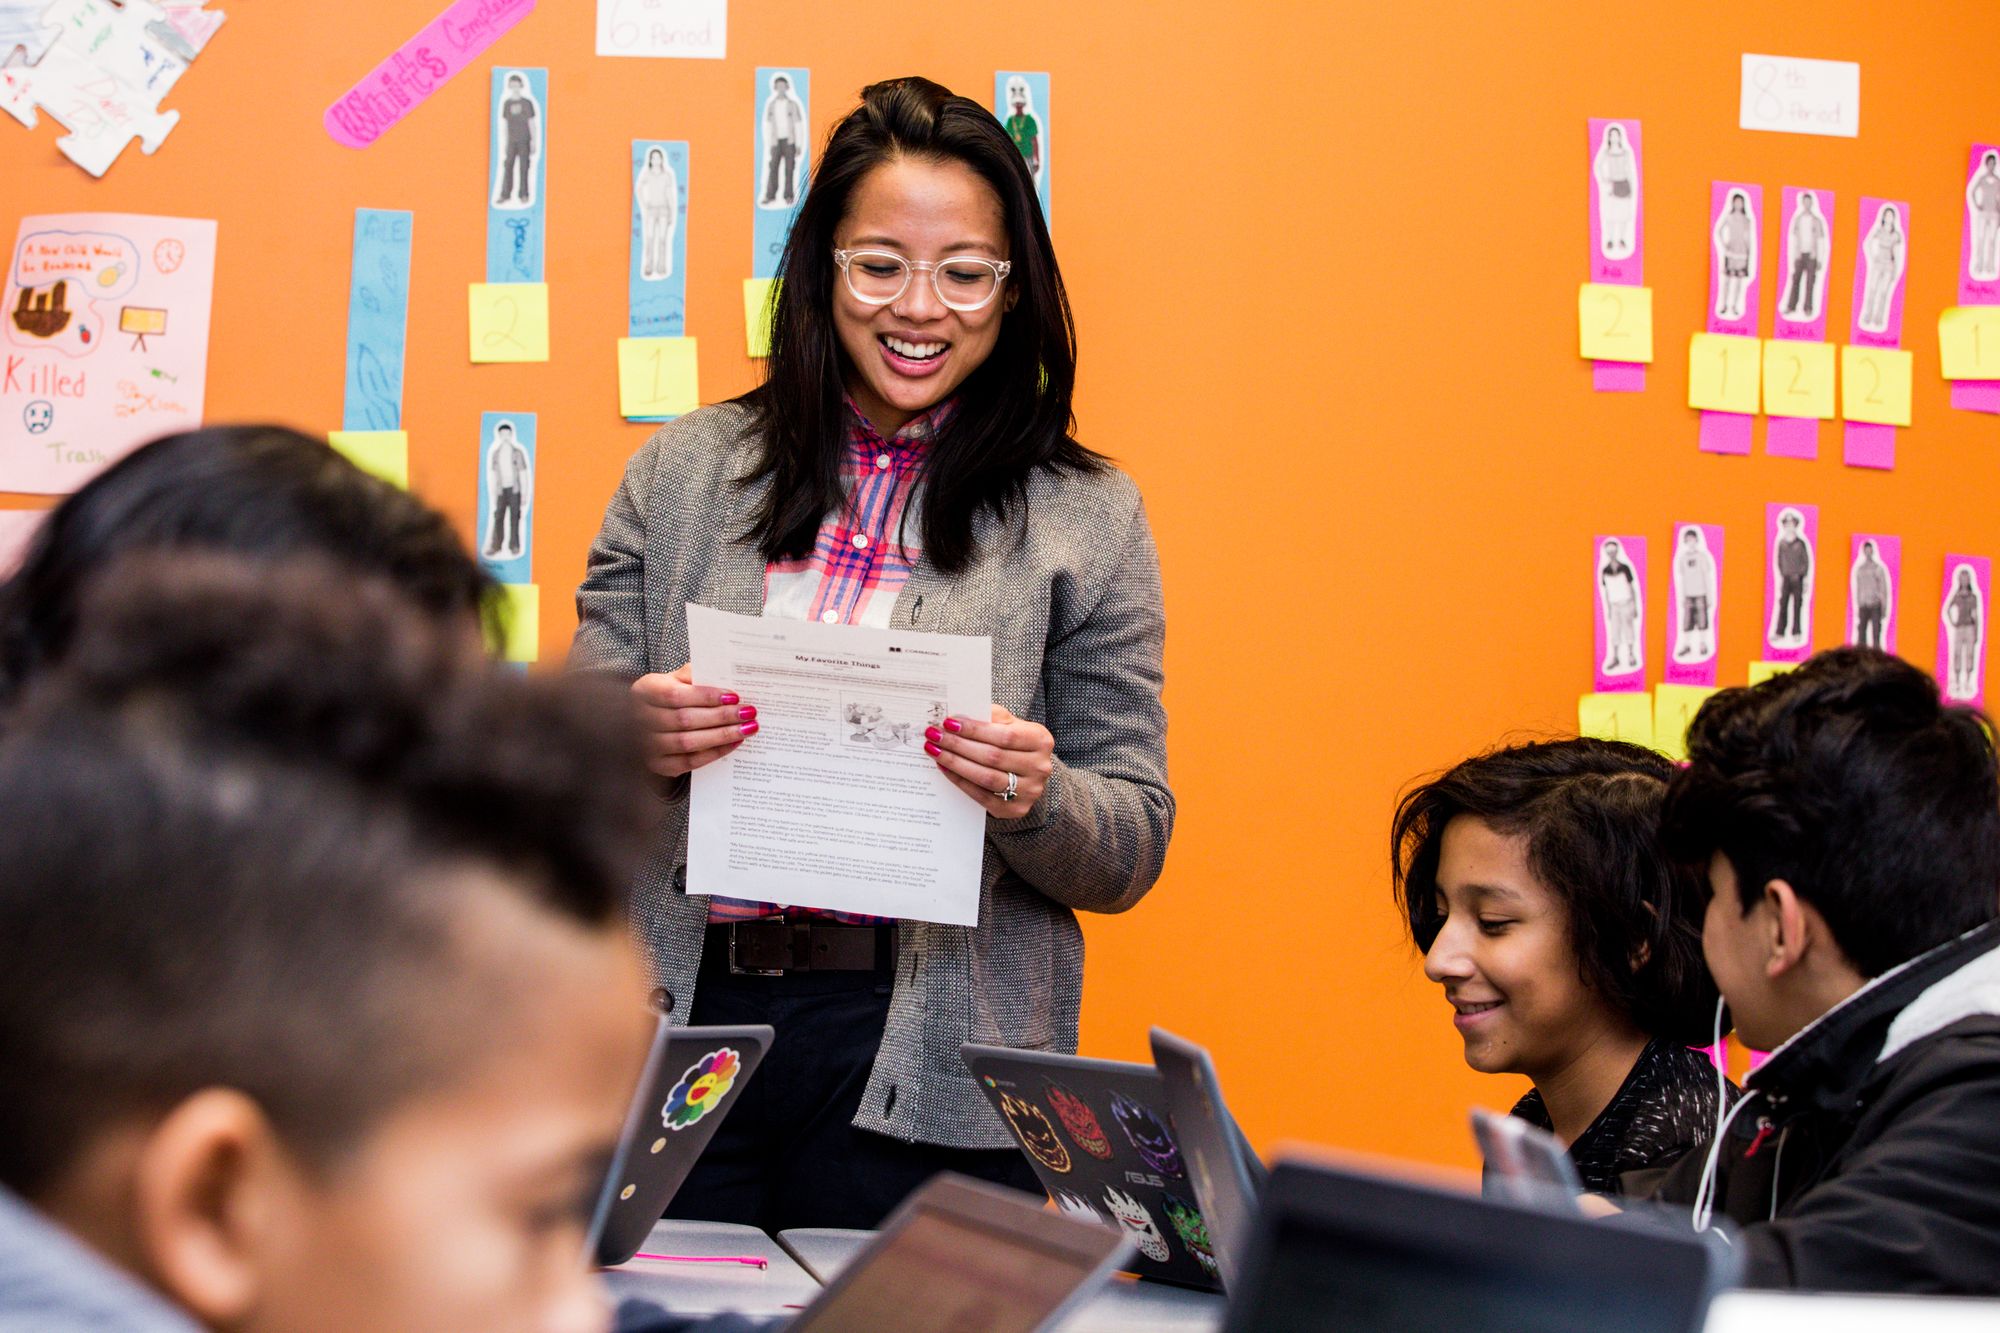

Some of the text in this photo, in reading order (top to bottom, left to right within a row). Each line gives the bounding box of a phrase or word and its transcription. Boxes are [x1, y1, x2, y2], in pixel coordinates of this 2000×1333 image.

[482, 296, 526, 350] 2
[1600, 292, 1631, 338] 2
[3, 355, 86, 398] Killed
[640, 347, 668, 404] 1
[1719, 347, 1728, 397] 1
[1787, 354, 1810, 396] 2
[1857, 356, 1884, 404] 2
[812, 656, 848, 666] Favorite
[852, 660, 881, 669] Things
[1125, 1171, 1165, 1188] ASUS
